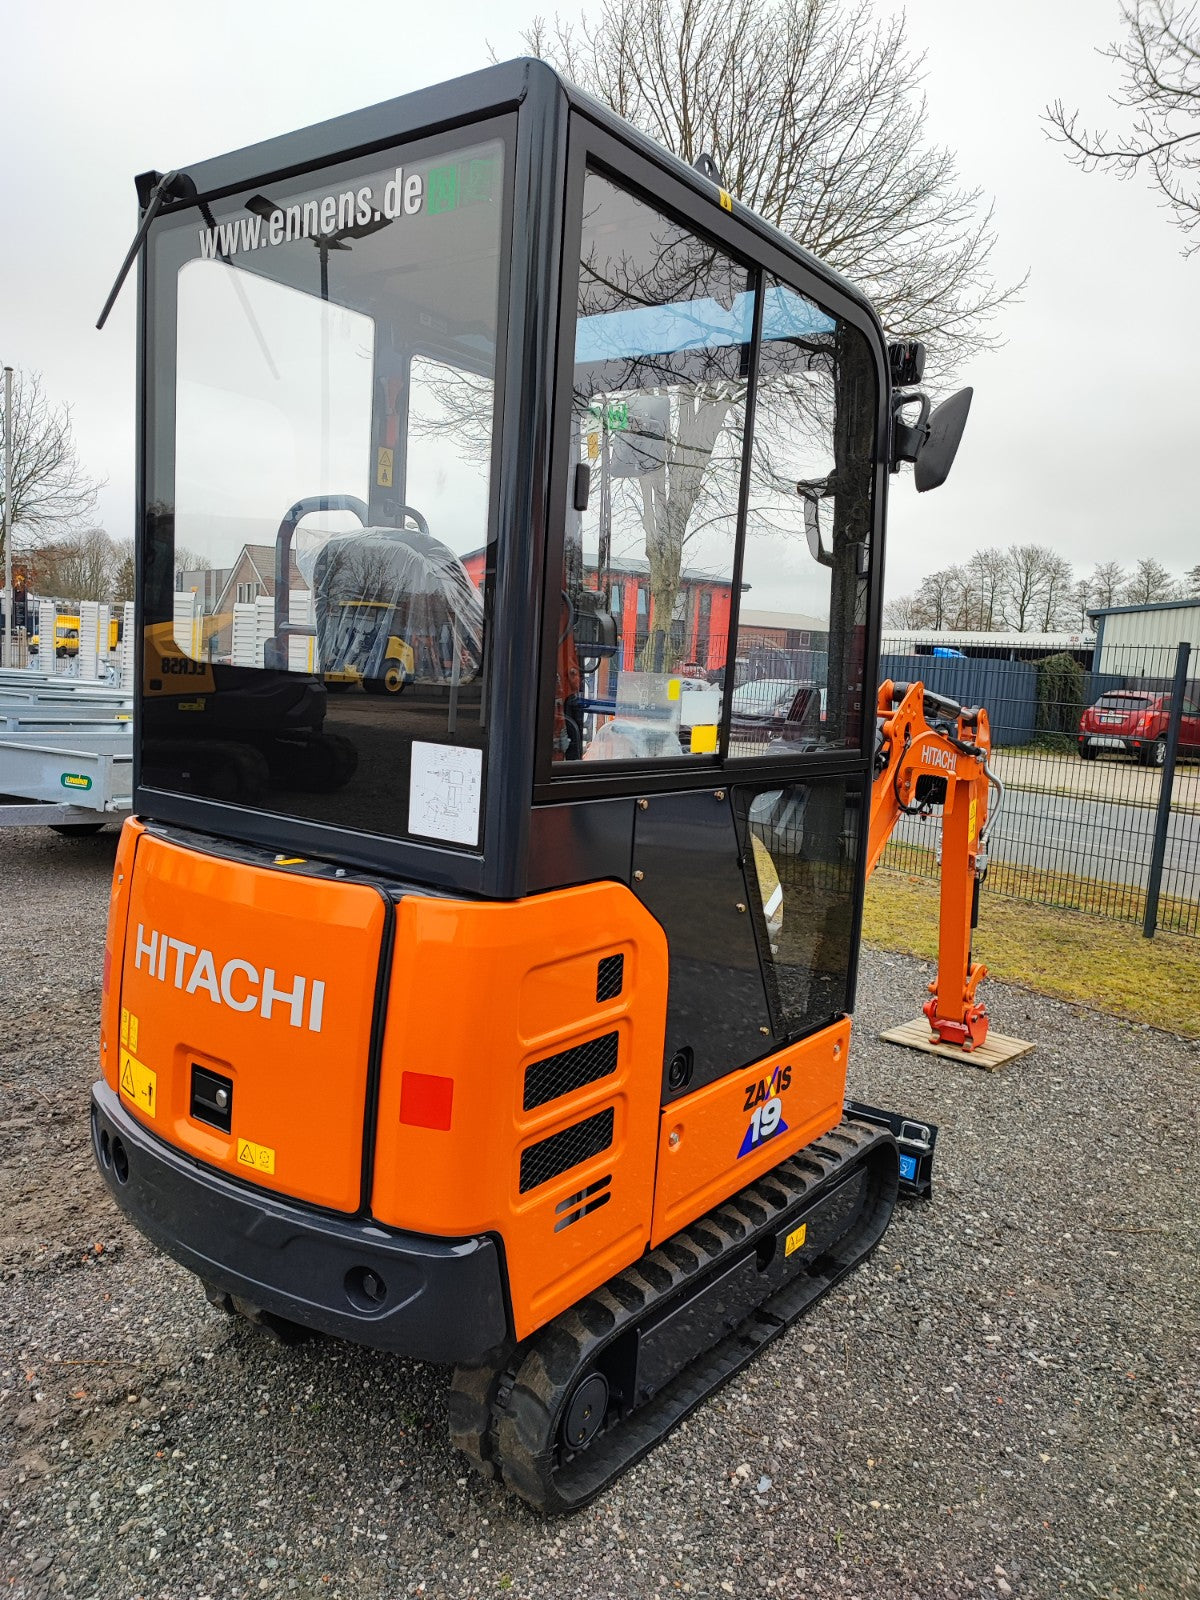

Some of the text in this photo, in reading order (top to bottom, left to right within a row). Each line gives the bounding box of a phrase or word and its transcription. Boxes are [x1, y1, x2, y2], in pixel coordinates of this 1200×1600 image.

[199, 167, 423, 259] www.ennens.de
[921, 744, 957, 771] HITACHI
[135, 923, 325, 1033] HITACHI
[743, 1065, 792, 1112] ZAXIS
[750, 1097, 782, 1144] 19
